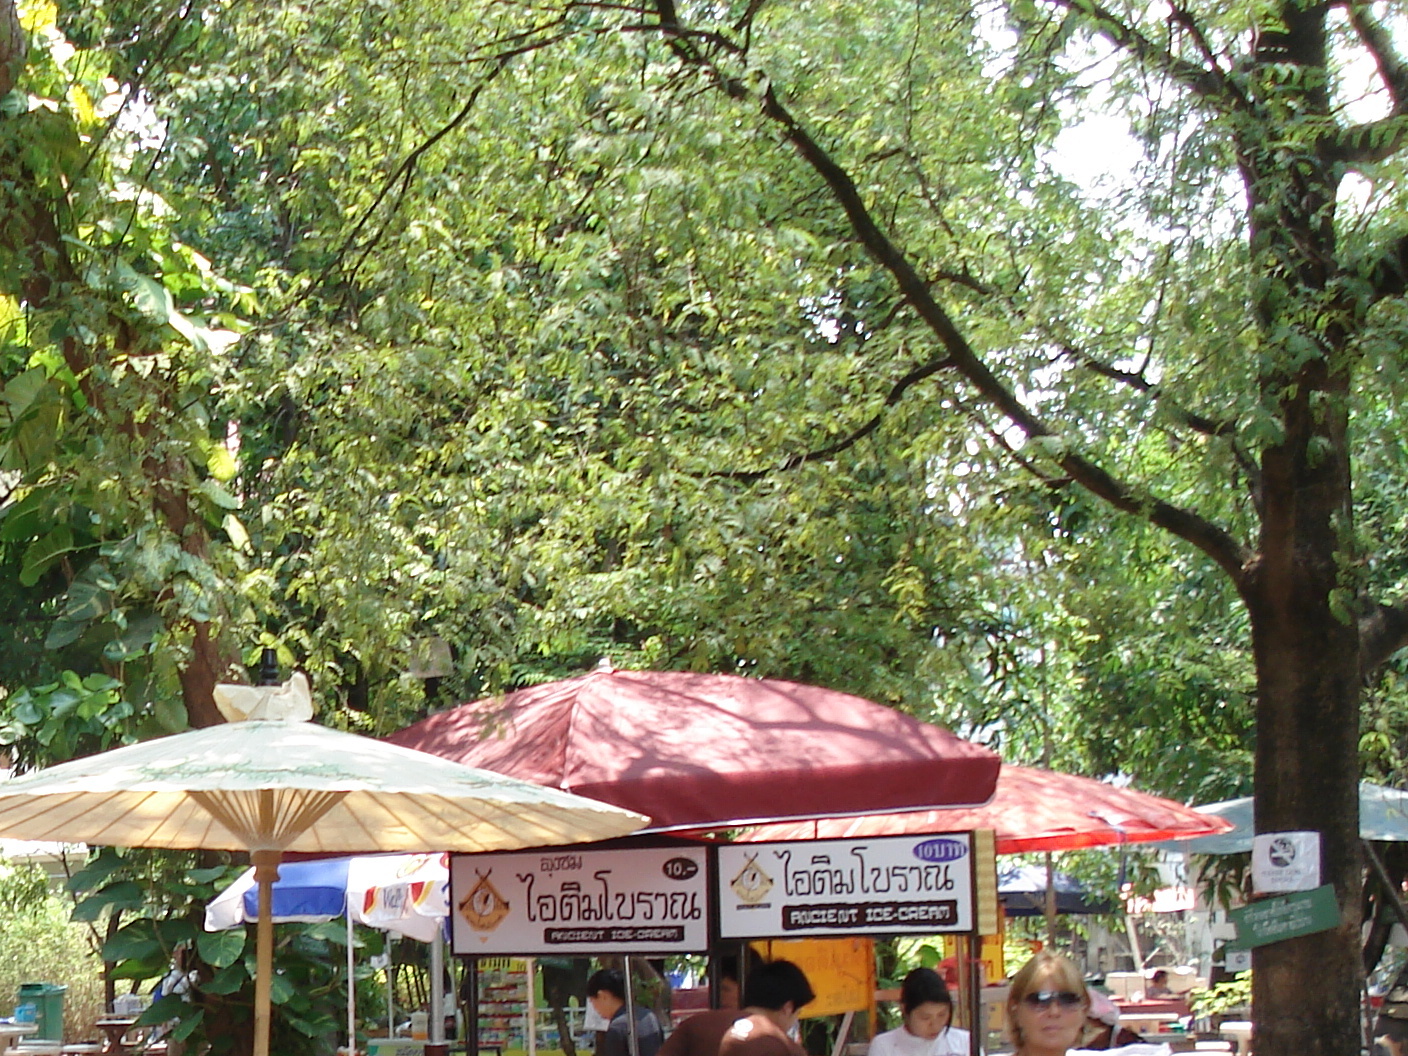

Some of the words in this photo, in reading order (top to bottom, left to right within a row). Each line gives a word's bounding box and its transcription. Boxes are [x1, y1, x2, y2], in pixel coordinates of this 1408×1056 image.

[774, 846, 955, 896] ไอติมโบราณ
[516, 869, 702, 923] ไอติมโบราณ
[790, 908, 858, 925] ANCIENT
[865, 905, 951, 923] ICE-CREAM
[550, 930, 605, 942] ANCIENT
[610, 929, 679, 941] ICE-CREAM
